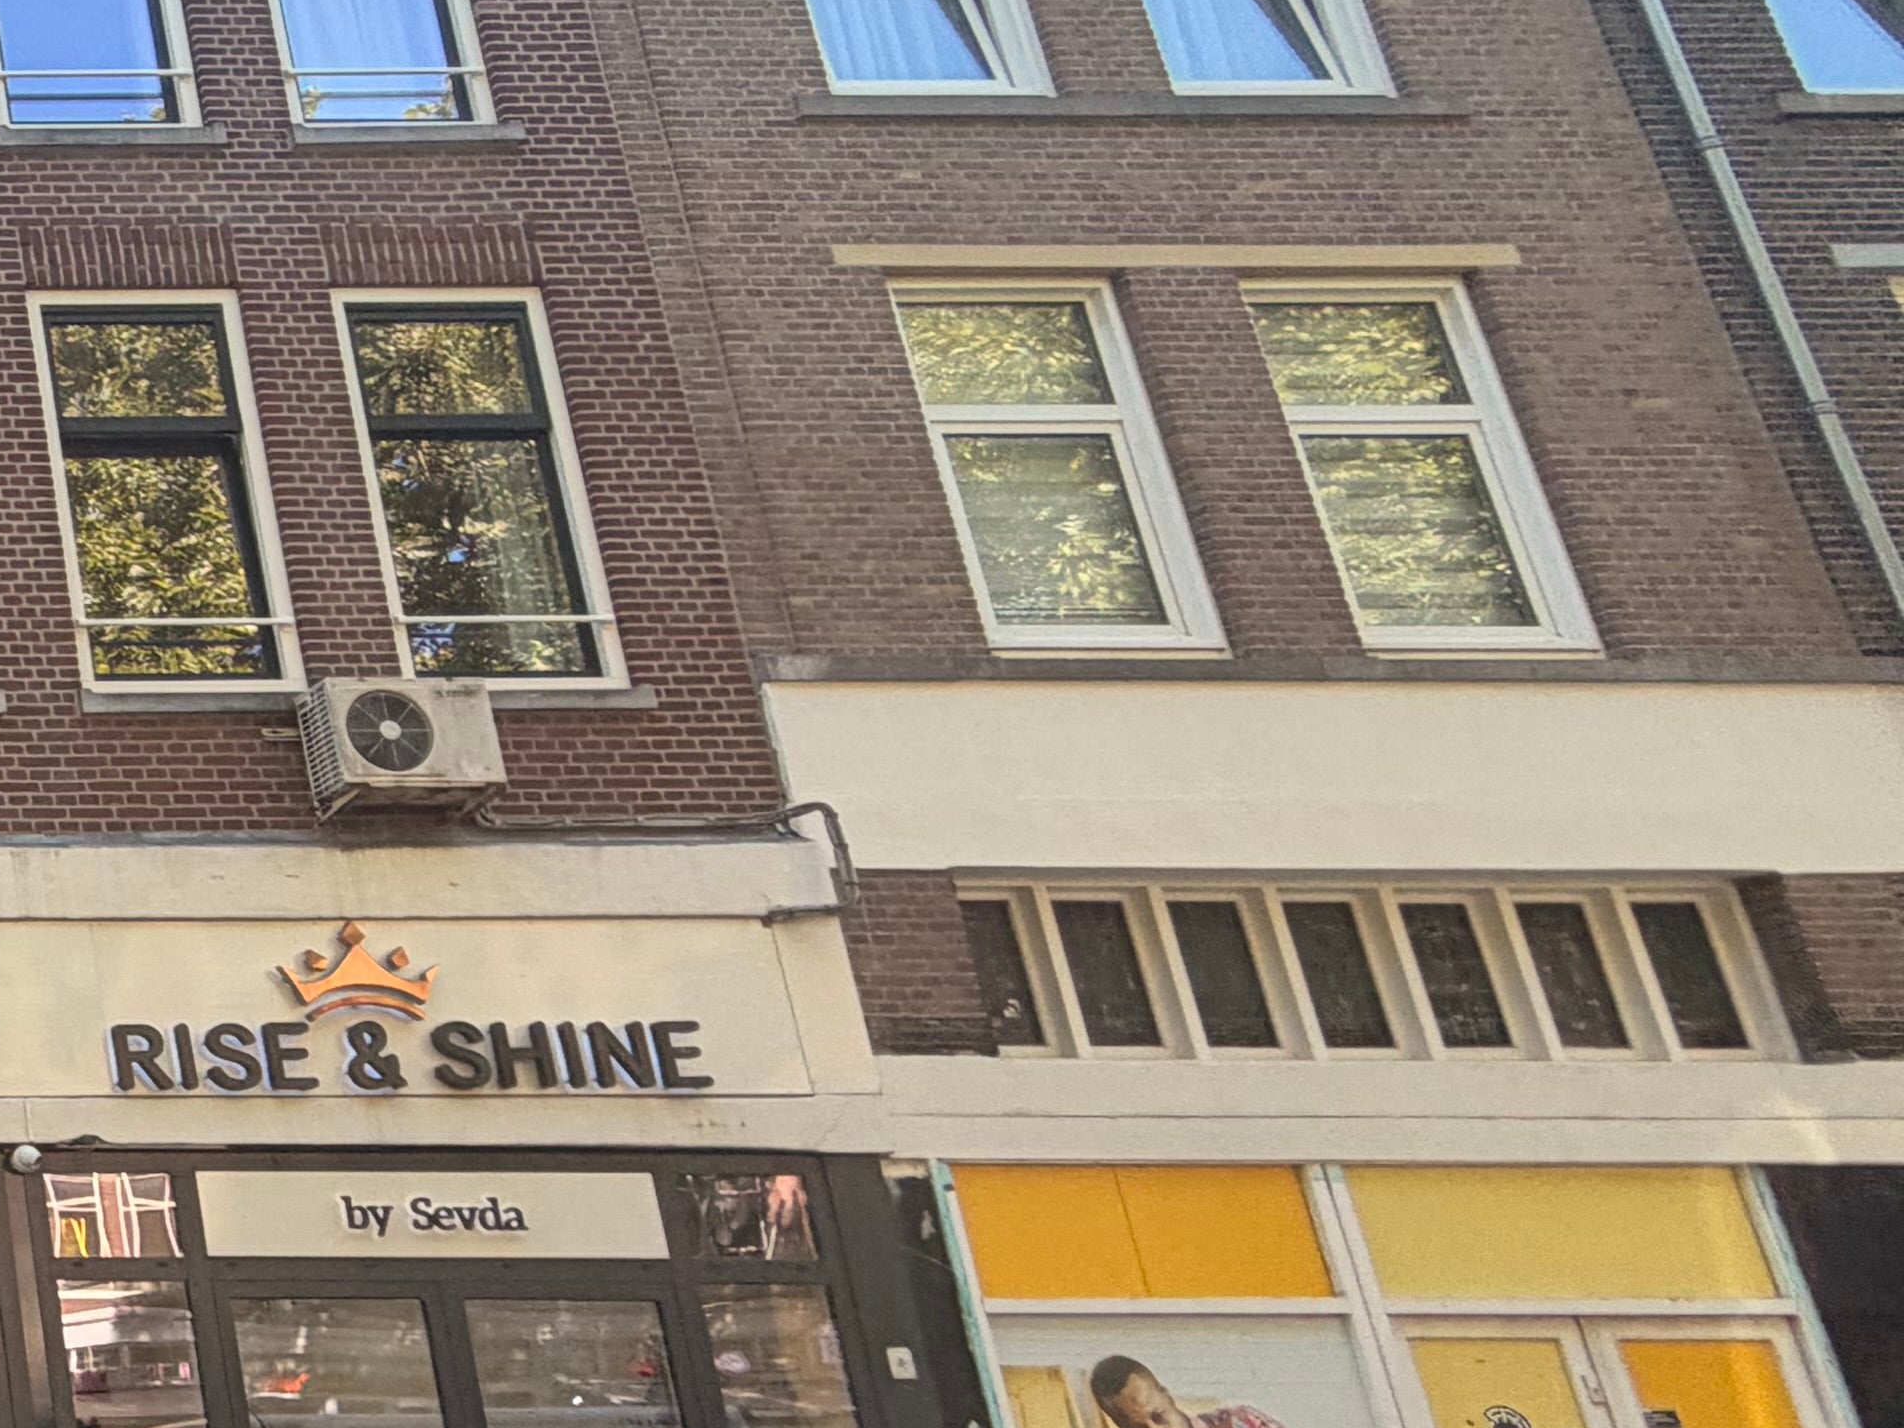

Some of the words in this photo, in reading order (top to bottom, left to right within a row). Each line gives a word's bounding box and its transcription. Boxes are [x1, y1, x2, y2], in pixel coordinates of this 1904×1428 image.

[110, 1021, 320, 1092] RISE
[343, 1020, 408, 1091] &
[430, 1021, 714, 1091] SHINE
[339, 1195, 394, 1237] by
[409, 1197, 529, 1231] Sevda
